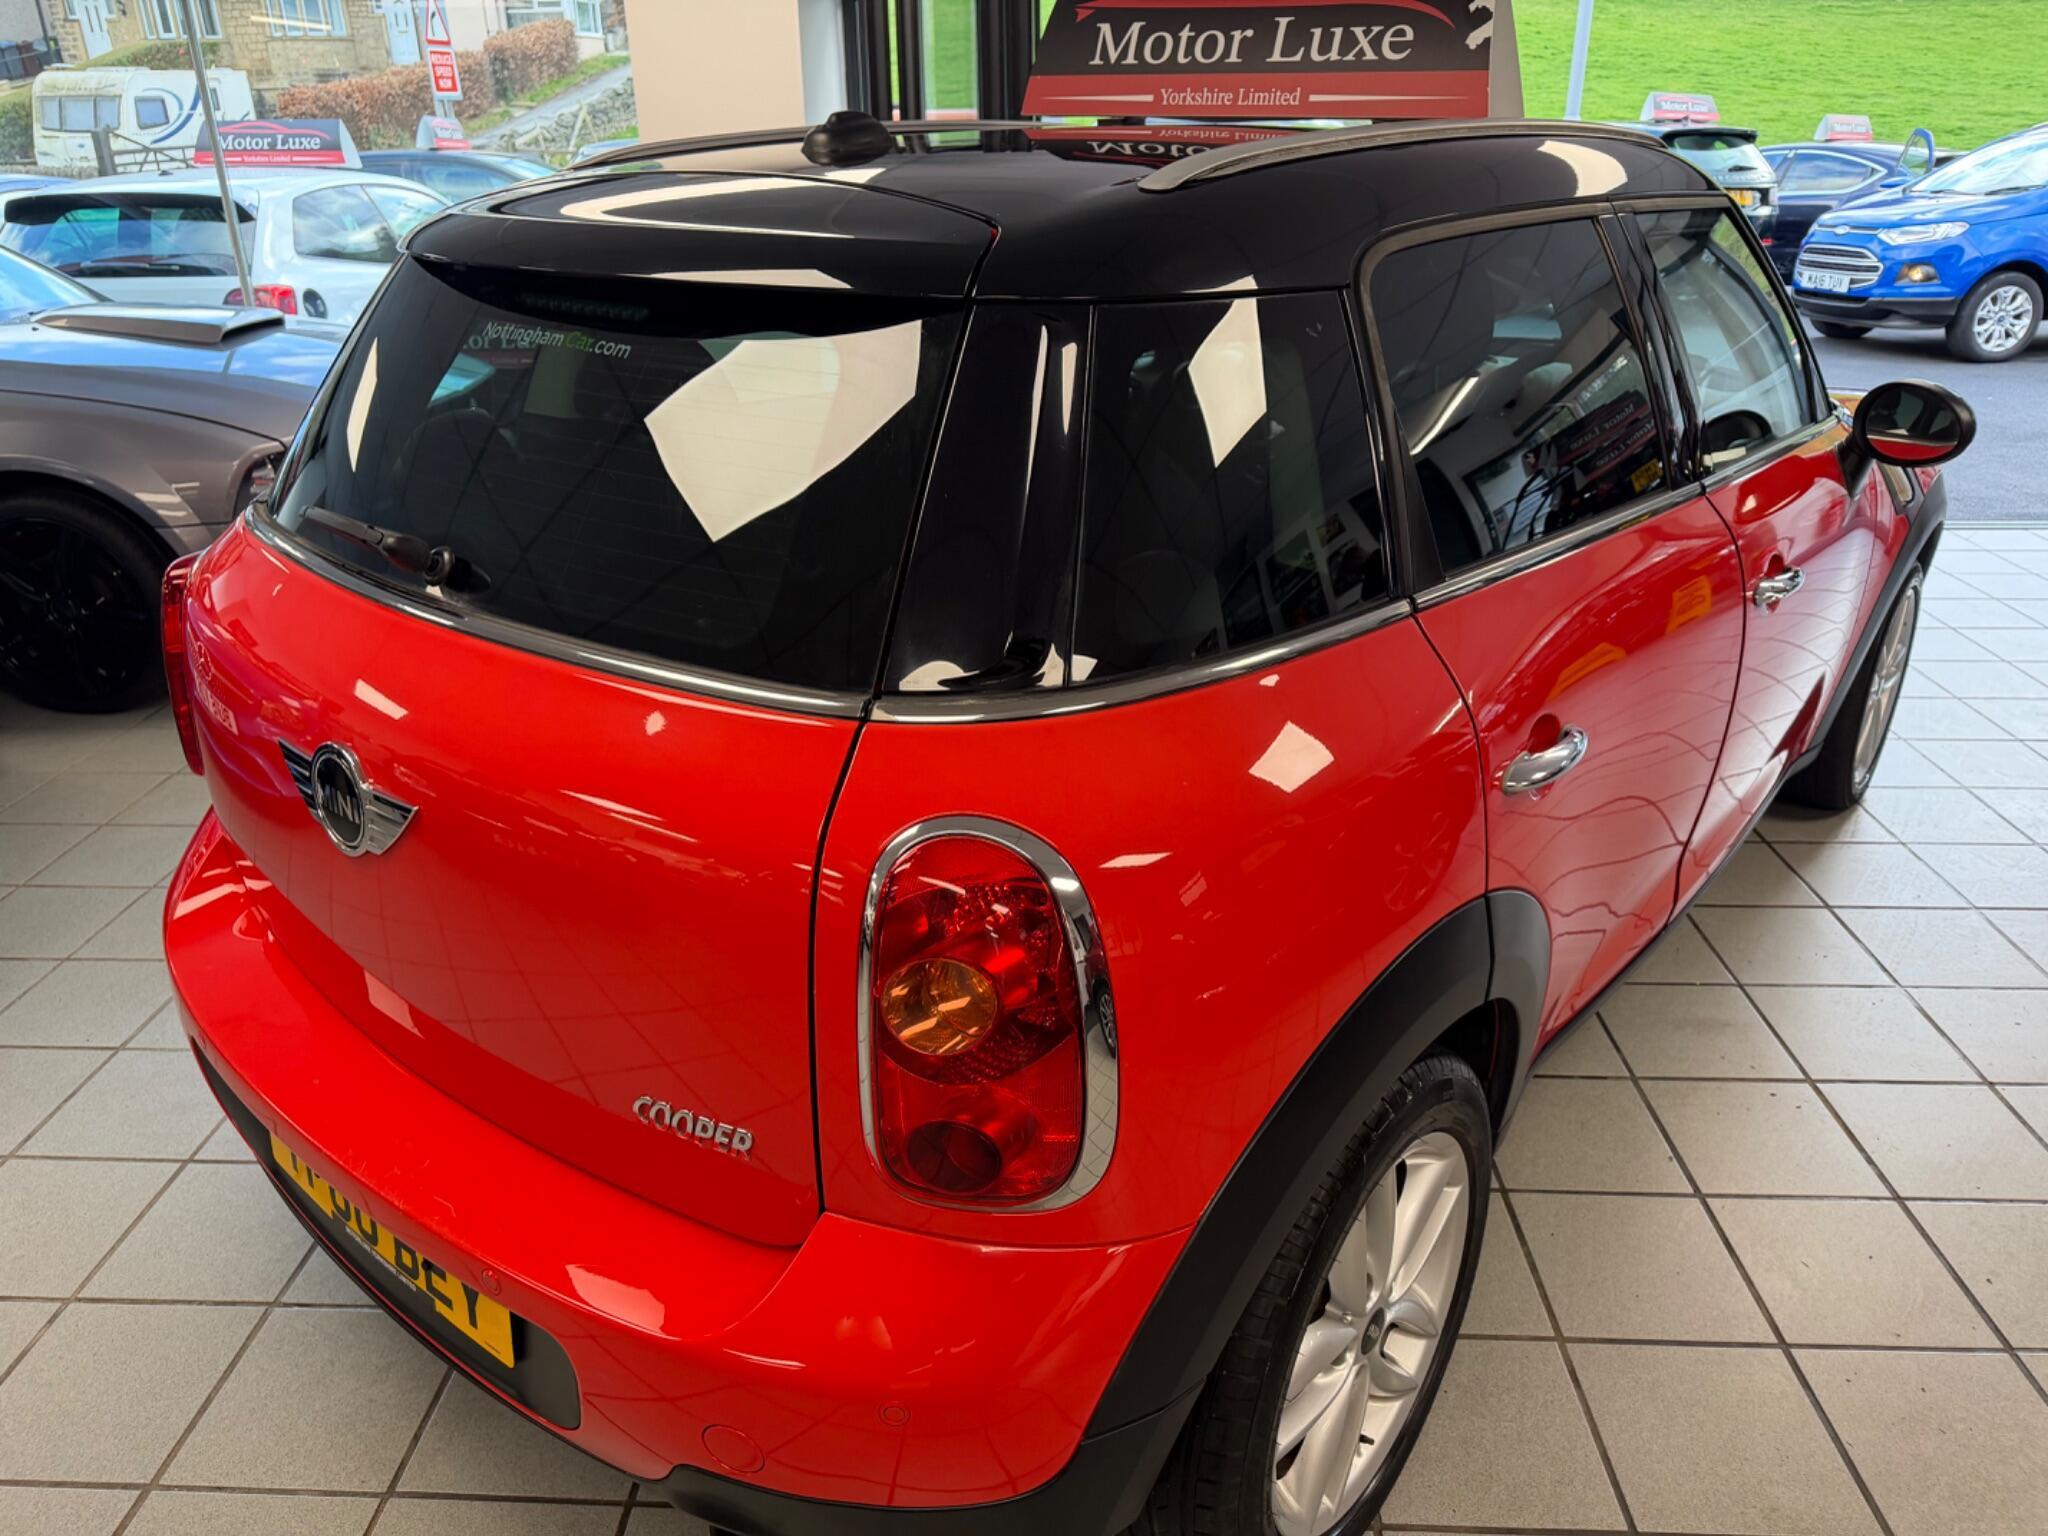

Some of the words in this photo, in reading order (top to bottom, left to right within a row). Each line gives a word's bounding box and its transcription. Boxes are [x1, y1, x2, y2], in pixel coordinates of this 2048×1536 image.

[1089, 21, 1253, 65] Motor
[1266, 17, 1414, 62] Luxe
[1159, 88, 1233, 106] Yorkshire
[1237, 87, 1300, 106] Limited
[219, 135, 271, 150] Motor
[276, 134, 321, 150] Luxe
[632, 1096, 753, 1160] COOPER
